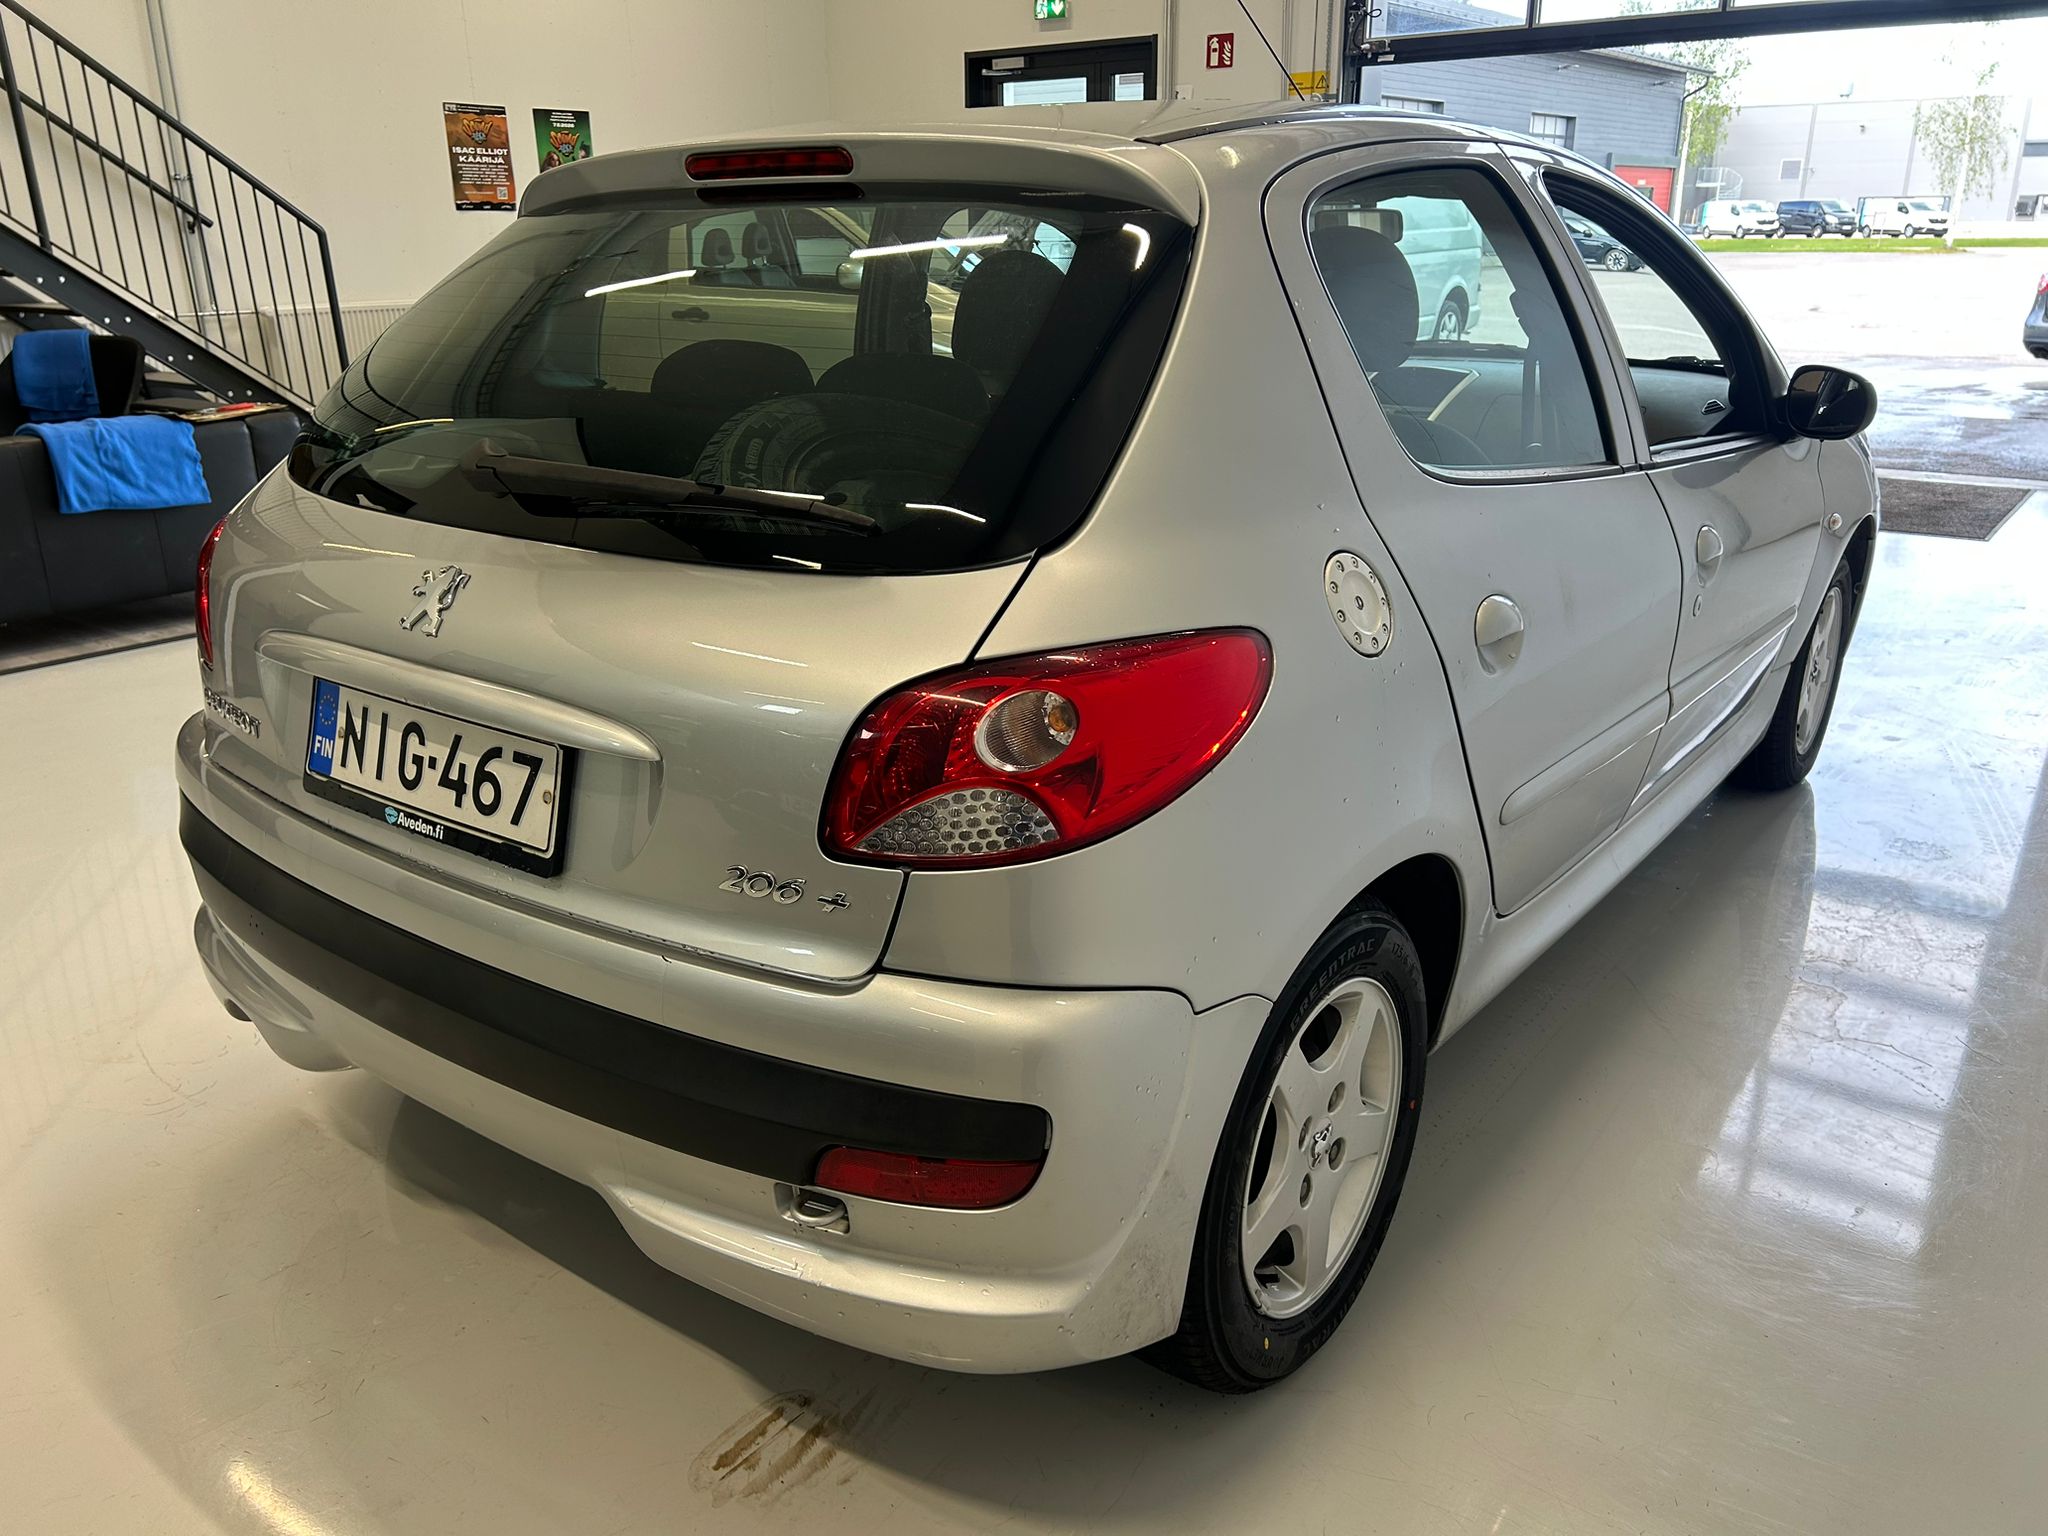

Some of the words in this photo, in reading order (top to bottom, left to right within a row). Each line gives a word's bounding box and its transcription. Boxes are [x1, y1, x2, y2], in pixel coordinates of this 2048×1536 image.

[452, 146, 475, 155] ISAC
[476, 147, 509, 156] ELLIOT
[458, 155, 505, 164] KÄÄRIJÄ
[204, 687, 262, 739] PEUGEOT
[314, 734, 334, 759] FIN
[339, 700, 544, 827] NIG-467
[397, 811, 444, 840] Aveden.fi
[718, 864, 807, 905] 206
